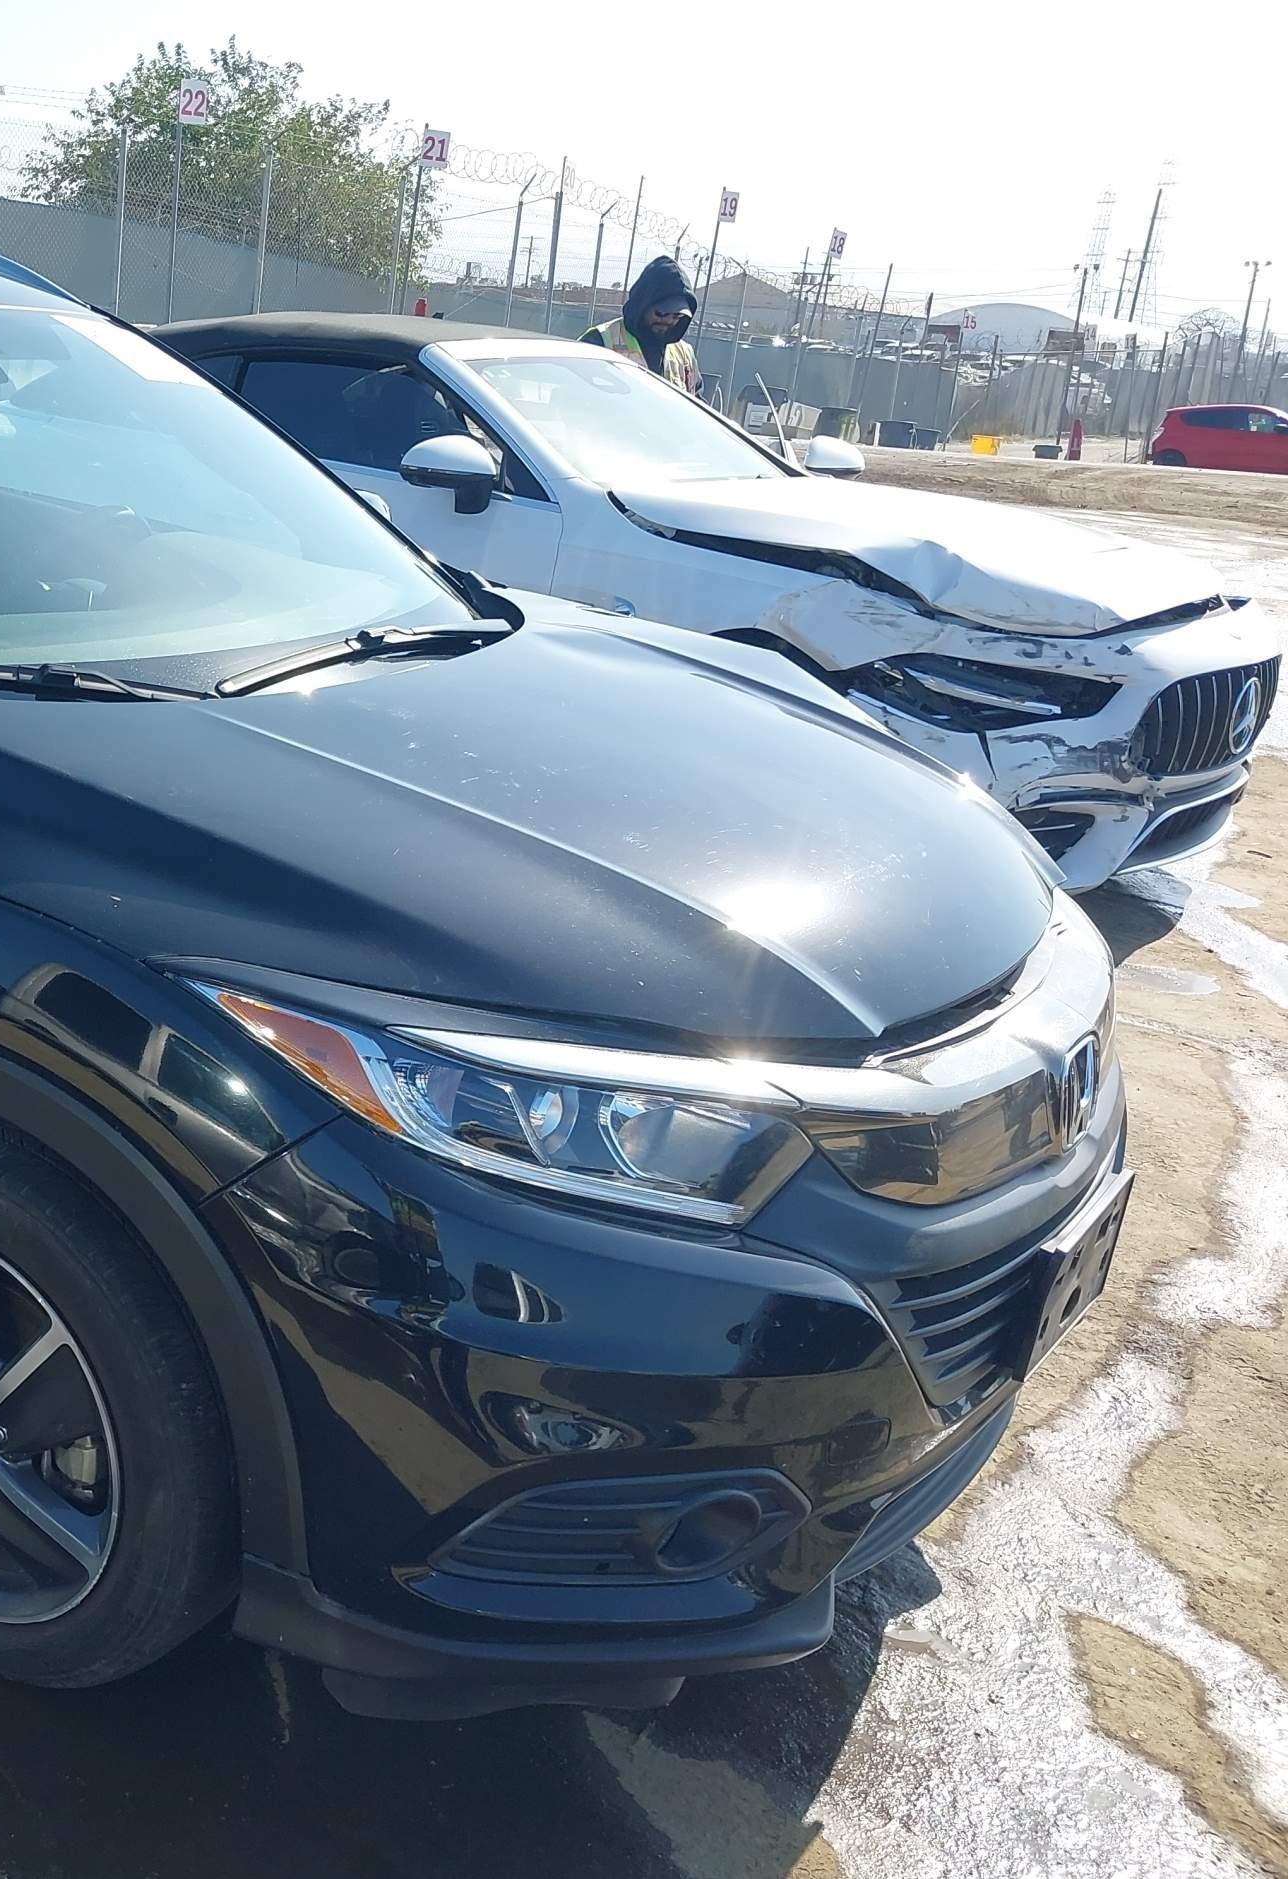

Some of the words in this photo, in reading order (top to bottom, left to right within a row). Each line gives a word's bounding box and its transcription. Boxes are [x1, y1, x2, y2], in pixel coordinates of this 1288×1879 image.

[181, 88, 206, 117] 22
[422, 136, 447, 162] 21
[564, 165, 576, 188] 20
[720, 197, 738, 218] 19
[830, 235, 845, 255] 18
[963, 314, 977, 330] 15
